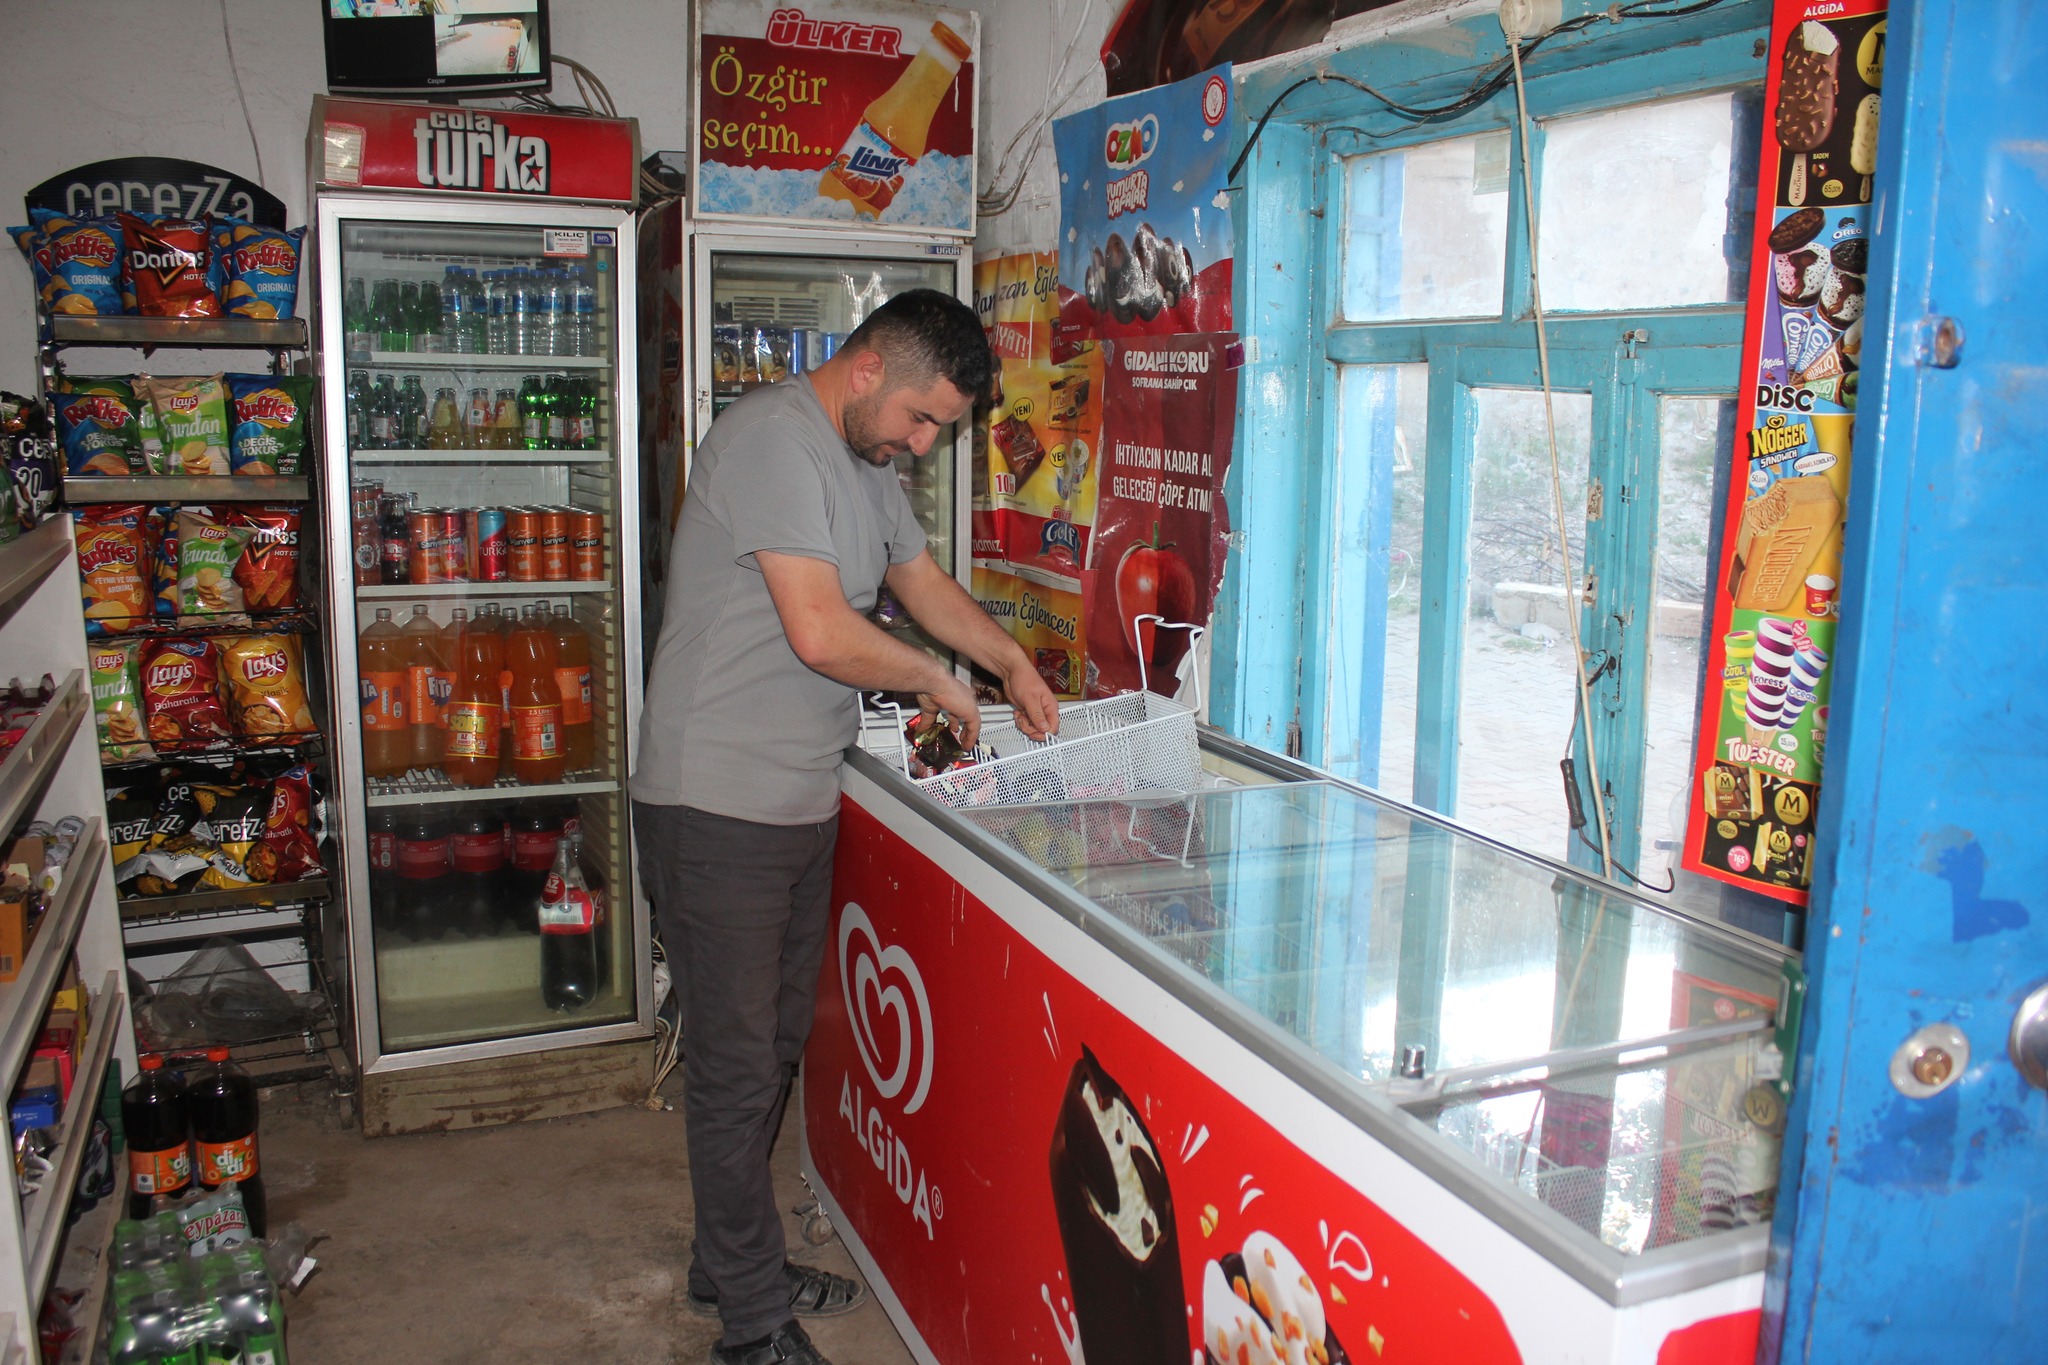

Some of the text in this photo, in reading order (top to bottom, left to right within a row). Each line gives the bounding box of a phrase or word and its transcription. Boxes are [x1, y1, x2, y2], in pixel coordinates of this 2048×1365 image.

[766, 9, 901, 58] ÜLKER
[427, 77, 447, 85] Casper
[709, 46, 828, 112] Özgür
[430, 110, 494, 132] cola
[860, 121, 892, 153] ÜLKER
[1106, 120, 1156, 164] OZMO
[1107, 170, 1148, 199] YUMURTA
[1832, 228, 1863, 240] OREO
[53, 233, 118, 268] Ruffles
[132, 250, 205, 270] Doritos
[234, 244, 298, 275] Ruffles
[1761, 358, 1785, 369] Milka
[1132, 376, 1197, 392] SOFRANA SAHİP ÇIK
[63, 397, 132, 429] Ruffles
[234, 394, 299, 424] Ruffles
[1751, 422, 1809, 458] NOGGER
[1115, 439, 1213, 477] İHTİYACIN KADAR AL
[1760, 449, 1798, 469] SANDWICH
[1113, 475, 1157, 503] GELECEĞİ
[1158, 479, 1185, 509] ÇÖPE
[1753, 526, 1813, 602] NOGGER
[1019, 591, 1078, 642] Eğlencesi
[1724, 666, 1746, 678] COOL
[154, 696, 200, 711] Baharatlı
[260, 687, 289, 699] Klasik
[1788, 687, 1817, 704] Ocean
